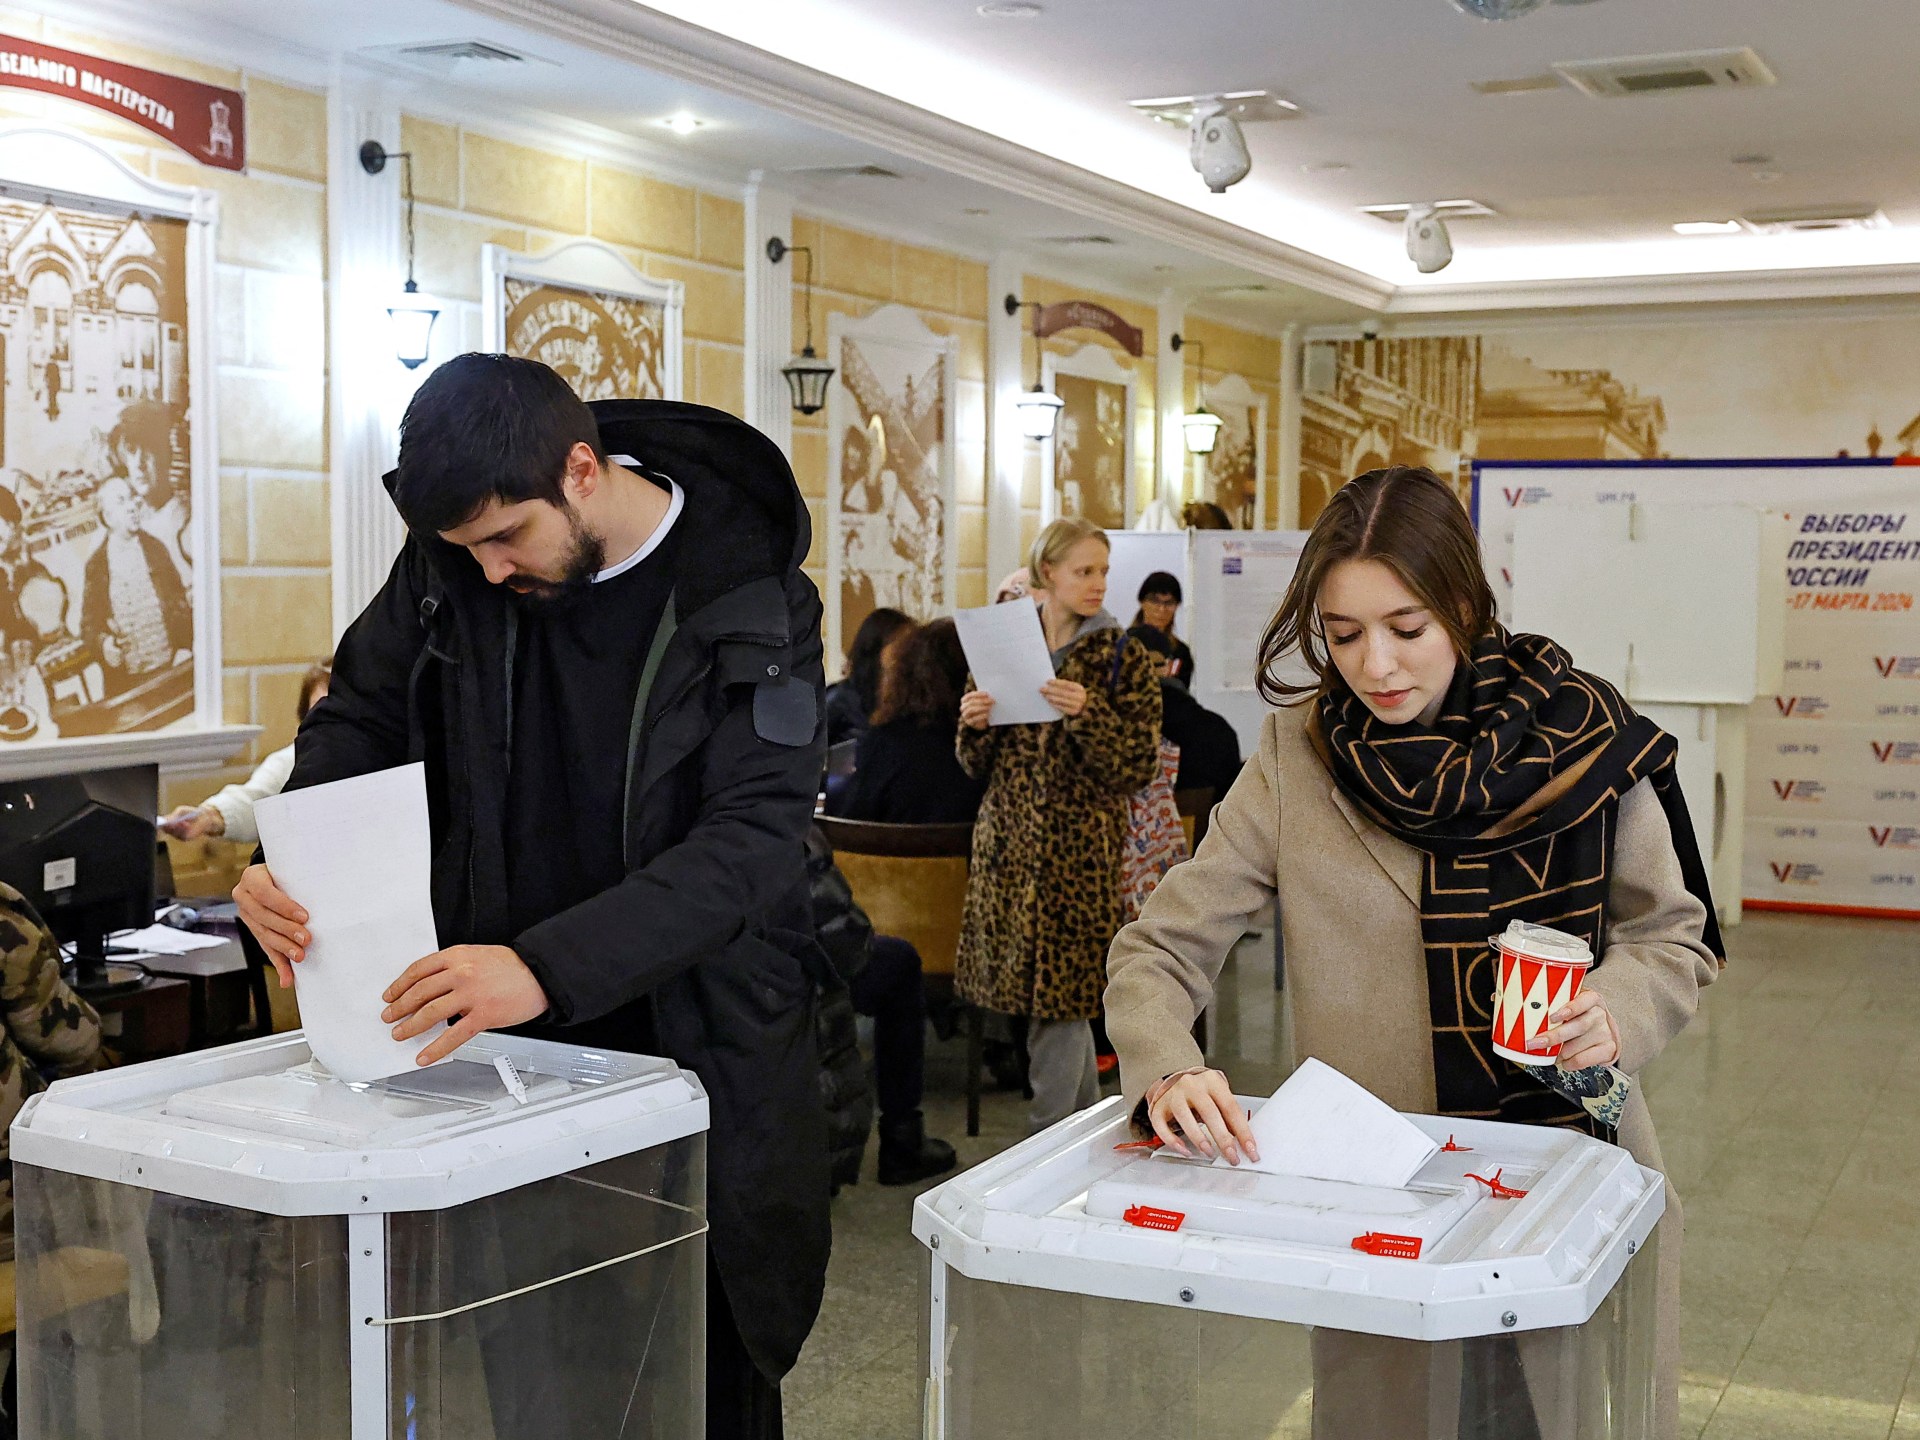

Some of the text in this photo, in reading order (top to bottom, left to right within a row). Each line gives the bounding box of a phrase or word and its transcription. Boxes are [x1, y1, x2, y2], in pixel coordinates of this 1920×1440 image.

[81, 70, 175, 130] МАСТЕРСТВА
[1800, 513, 1907, 533] ВЫБОРЫ
[1811, 592, 1870, 610] МАРТА
[1871, 592, 1914, 611] 2024
